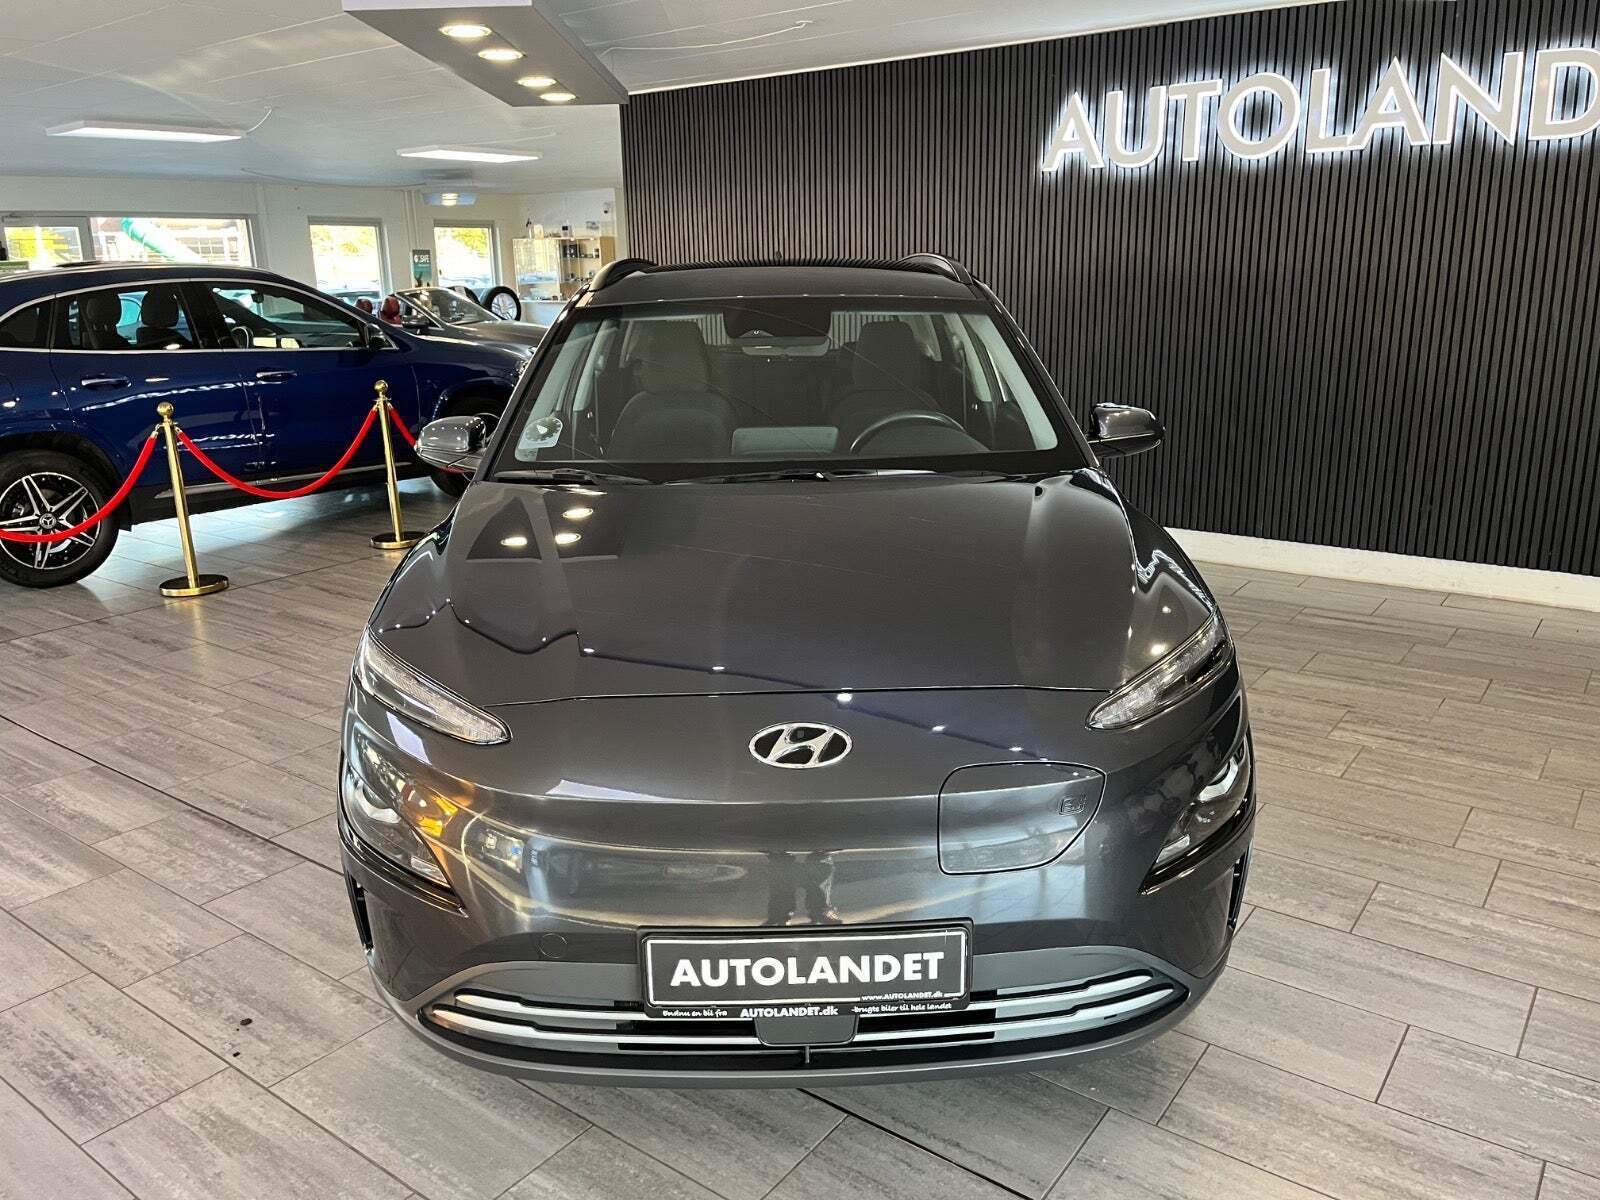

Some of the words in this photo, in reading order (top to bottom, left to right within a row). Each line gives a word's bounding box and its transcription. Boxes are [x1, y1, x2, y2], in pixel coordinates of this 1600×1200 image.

[1041, 48, 1600, 172] AUTOLAND
[670, 951, 944, 987] AUTOLANDET
[861, 990, 943, 1001] www.AUTOLANDET.dk
[703, 1009, 715, 1017] bil
[715, 1009, 728, 1018] fra
[740, 1005, 838, 1018] AUTOLANDET.dk
[881, 1004, 898, 1012] biler
[900, 1003, 909, 1011] til
[911, 1003, 926, 1011] hele
[927, 1002, 952, 1010] landet
